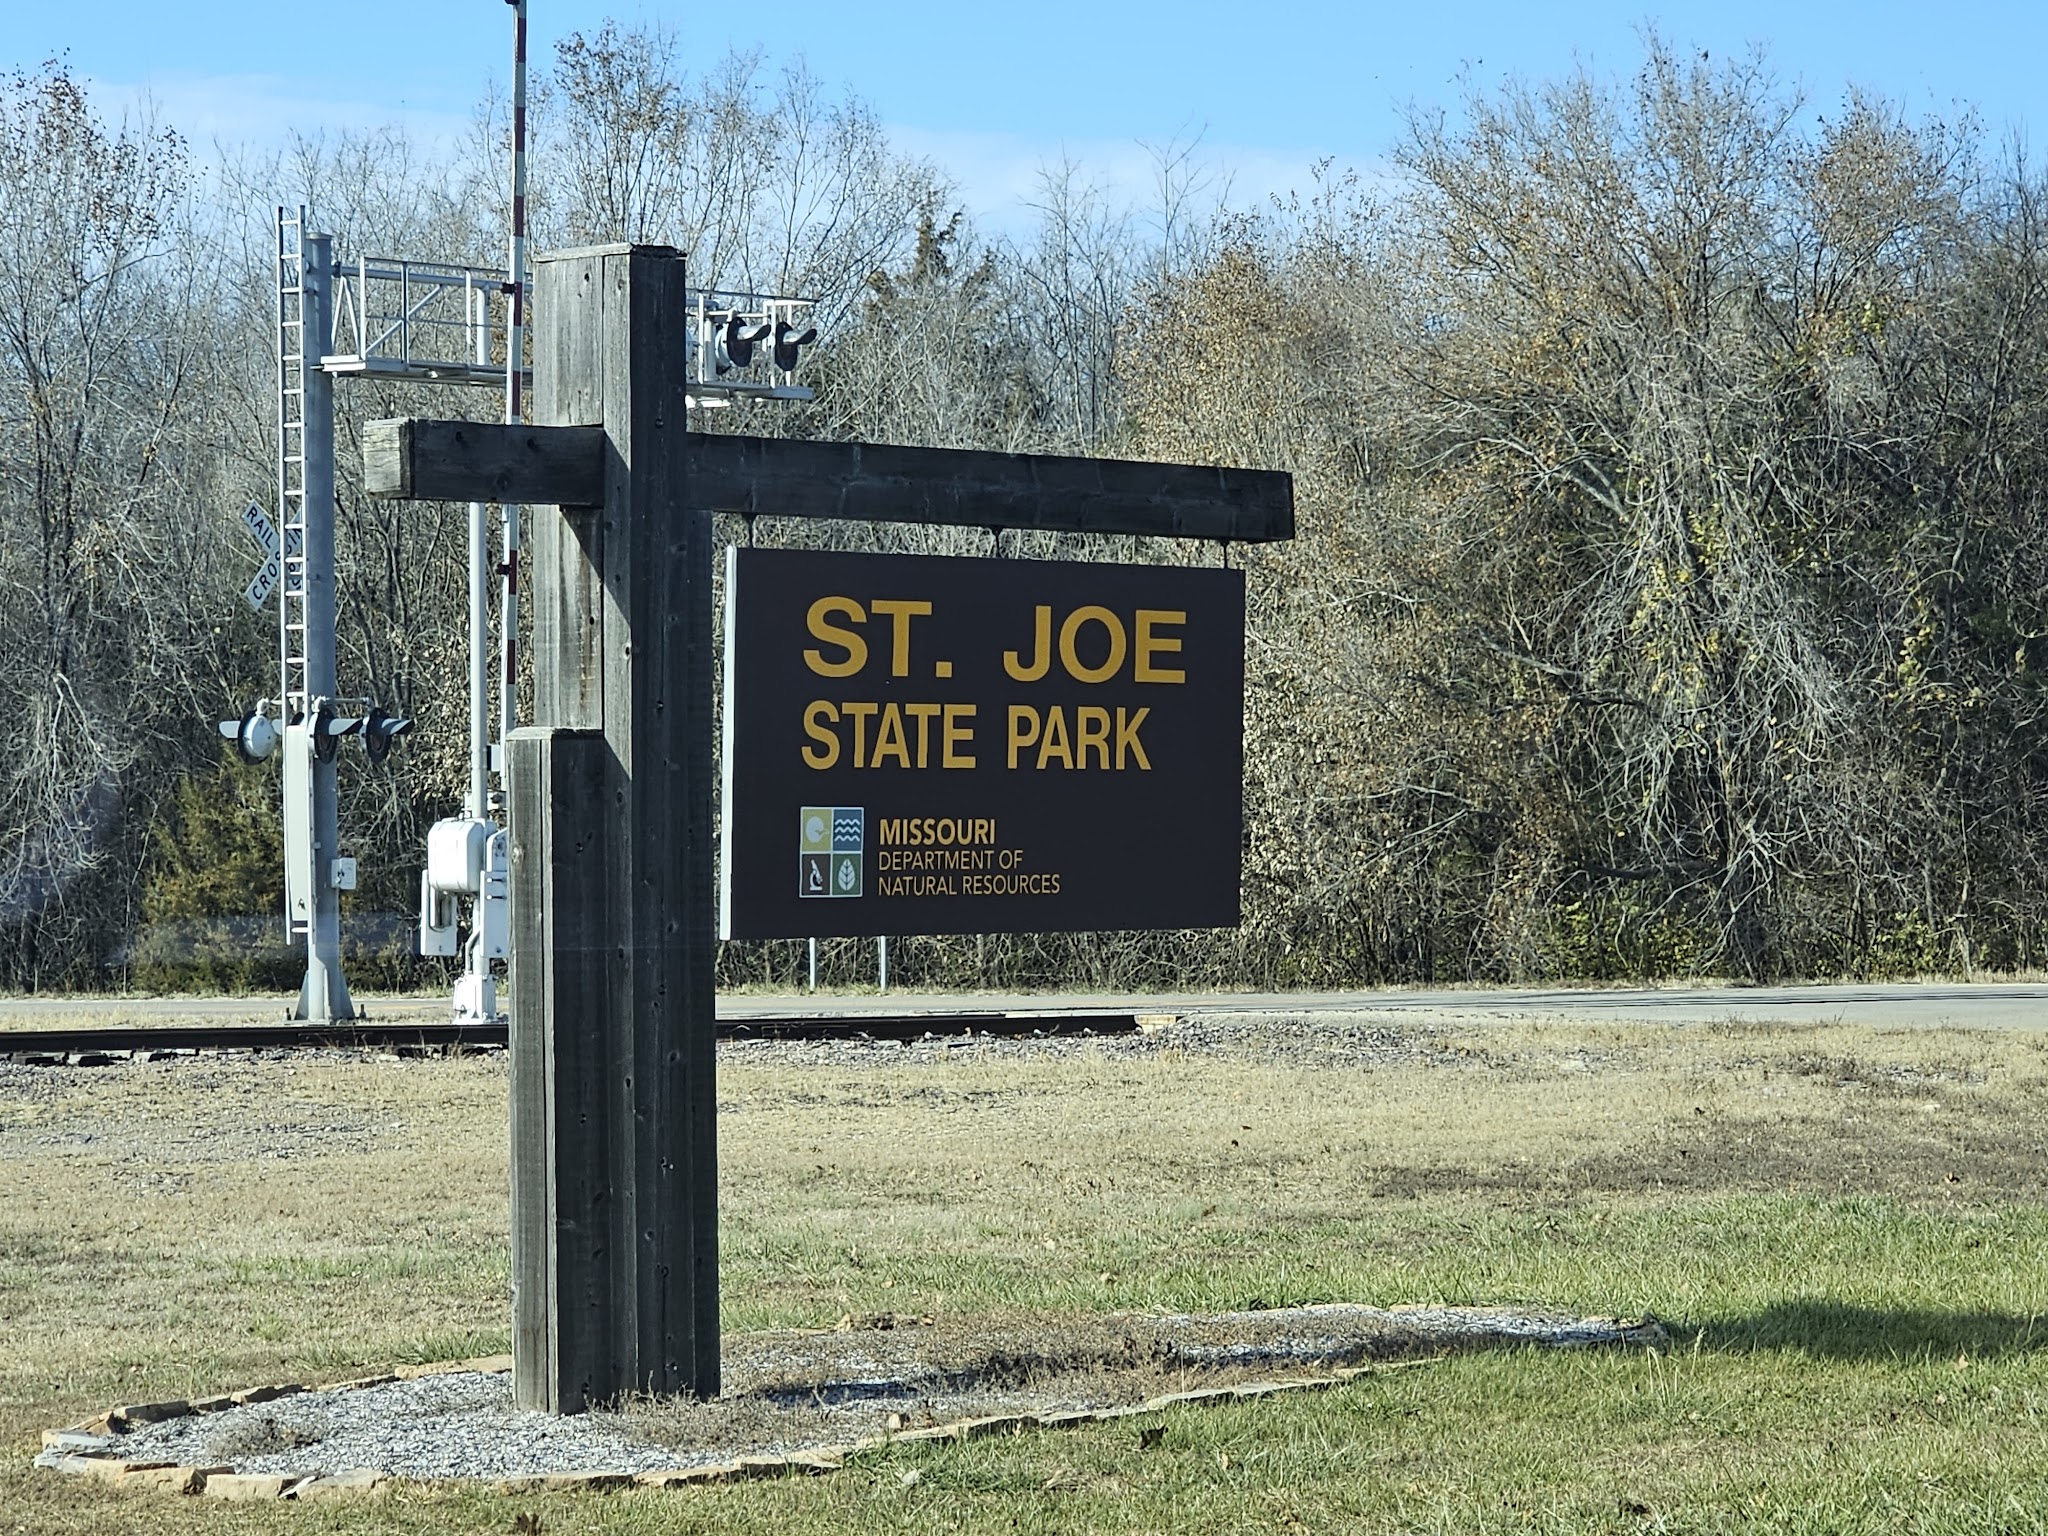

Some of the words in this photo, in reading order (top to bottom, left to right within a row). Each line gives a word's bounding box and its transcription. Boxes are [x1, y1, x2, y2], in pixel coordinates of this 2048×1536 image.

[247, 506, 272, 549] RAIL
[803, 596, 953, 678] ST.
[1003, 605, 1187, 684] JOE
[801, 700, 977, 770] STATE
[1007, 704, 1152, 770] PARK
[879, 817, 996, 845] MISSOURI
[878, 850, 995, 871] DEPARTMENT
[998, 849, 1024, 870] OF
[878, 876, 957, 896] NATURAL
[962, 874, 1061, 895] RESOURCES
